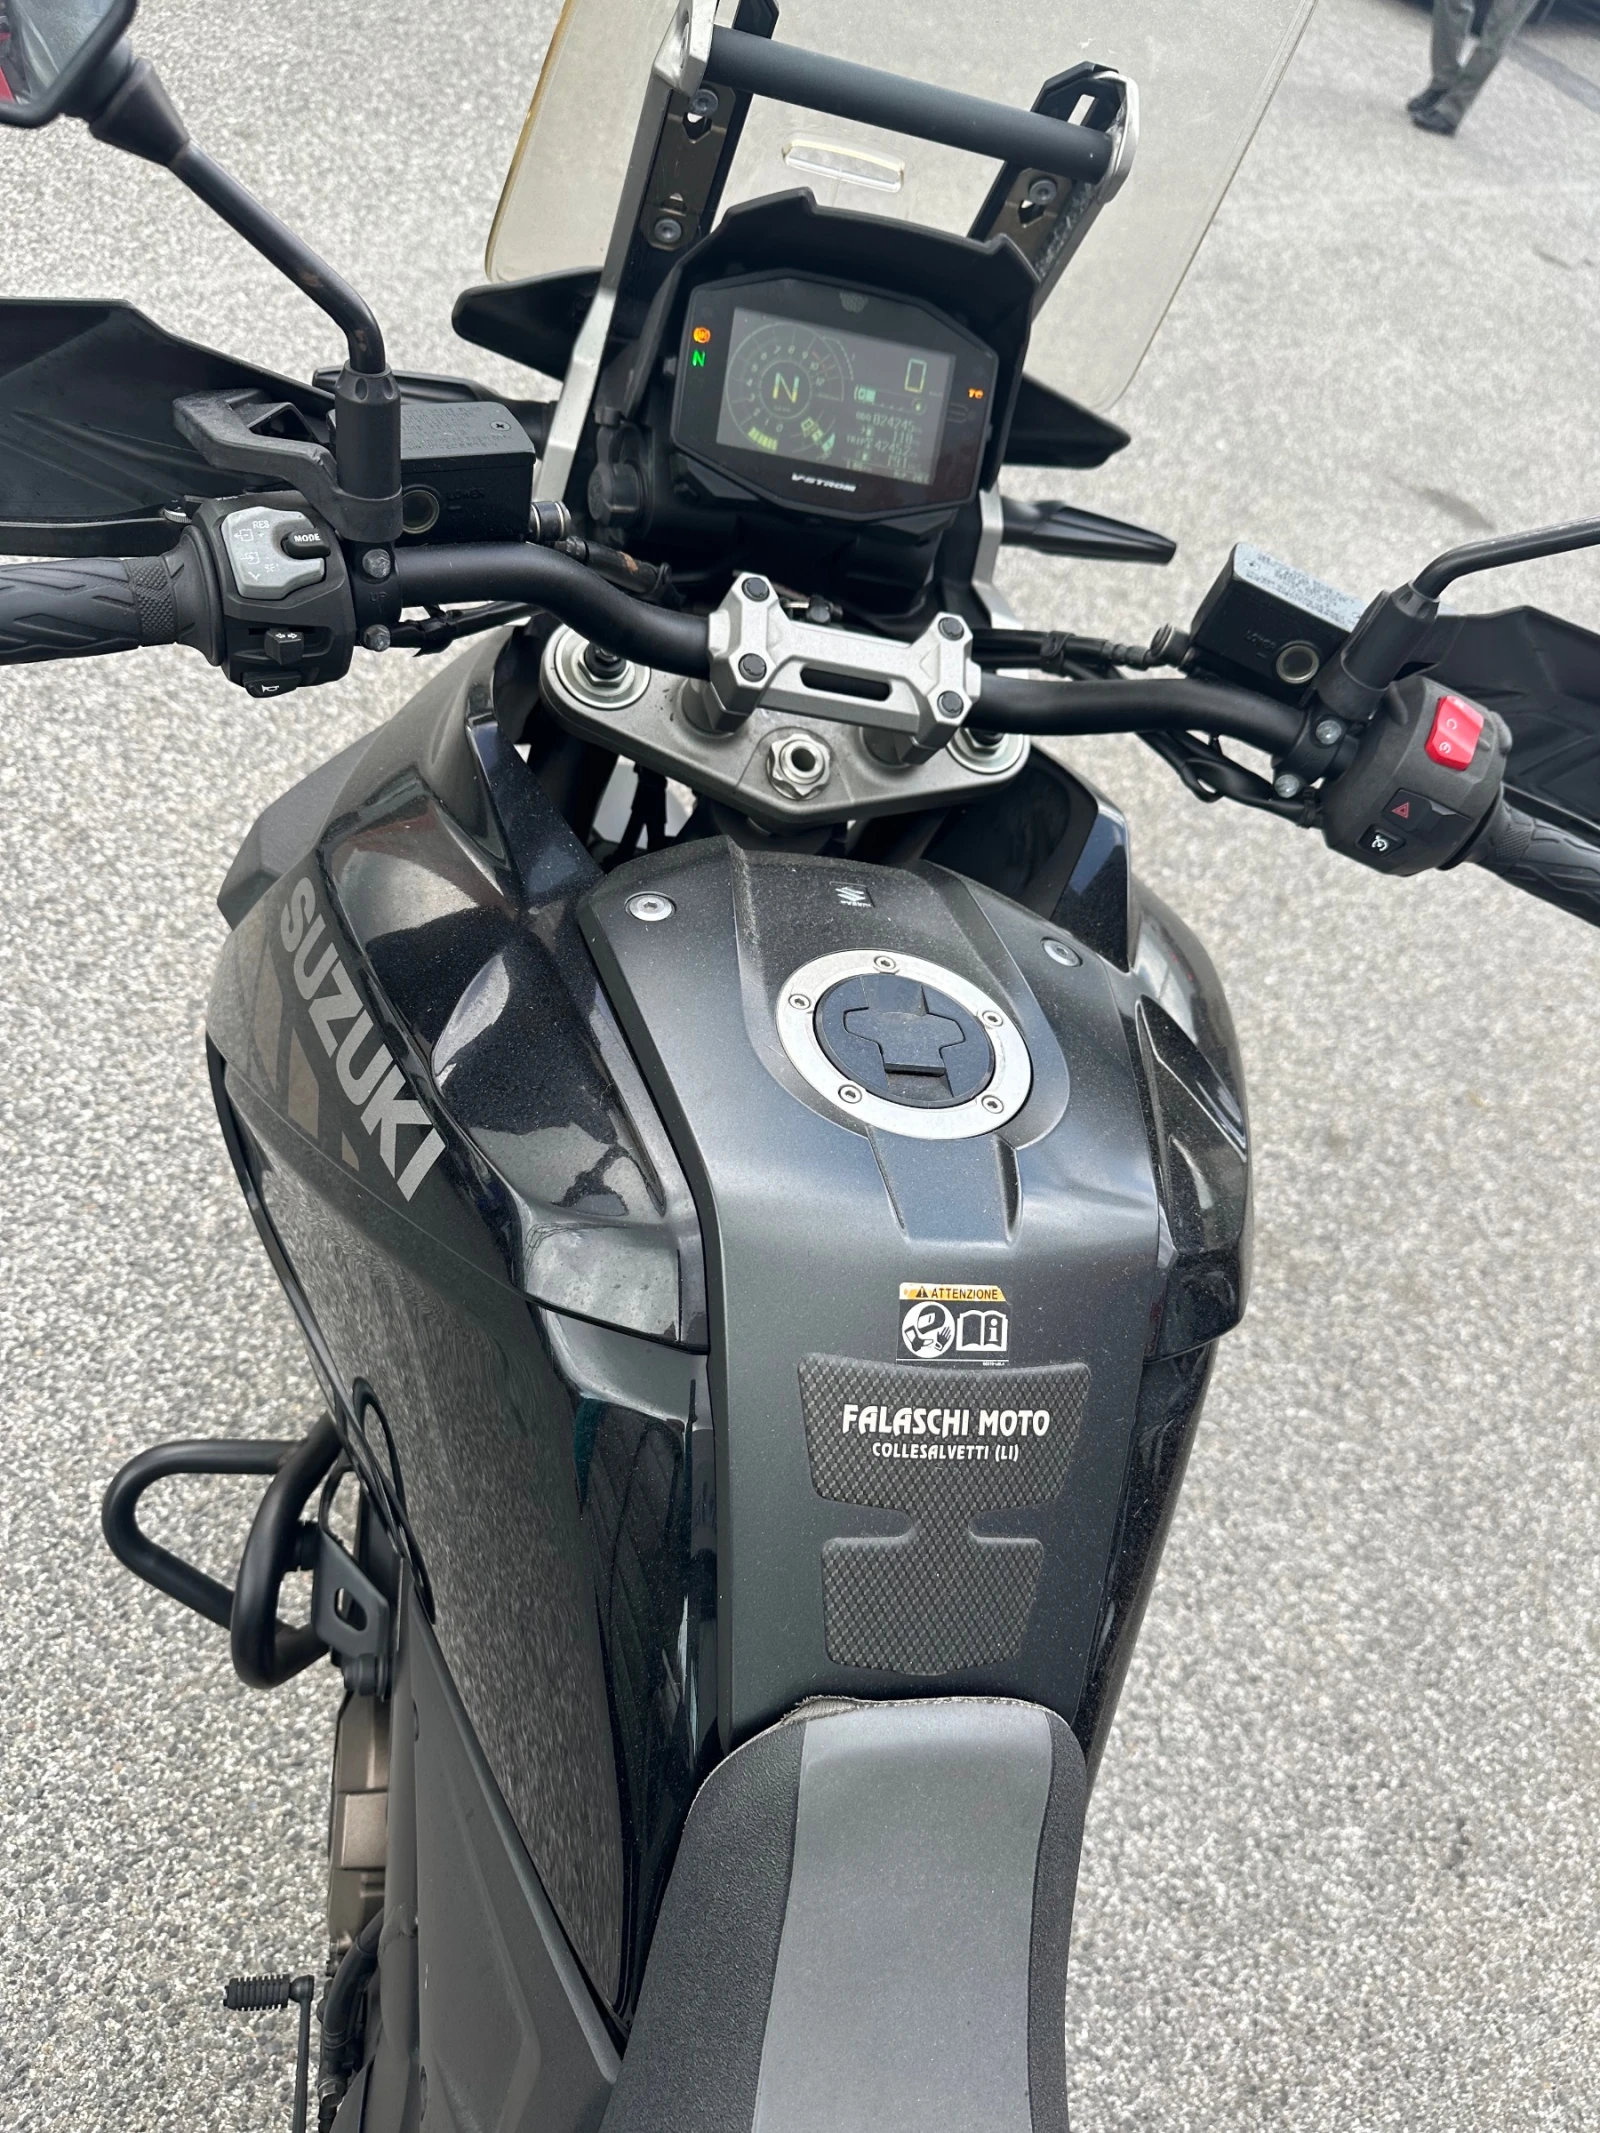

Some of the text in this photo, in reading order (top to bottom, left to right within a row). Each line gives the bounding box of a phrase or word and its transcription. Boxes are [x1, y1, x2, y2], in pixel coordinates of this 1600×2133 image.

[692, 349, 706, 368] N
[772, 372, 800, 404] N
[253, 520, 270, 530] RES
[294, 533, 321, 543] MODE
[280, 876, 446, 1202] SUZUKI
[931, 1287, 999, 1300] ATTENZIONE
[841, 1403, 1051, 1439] FALASCHI MOTO
[872, 1441, 1019, 1462] COLLESALVETTI (LI)
